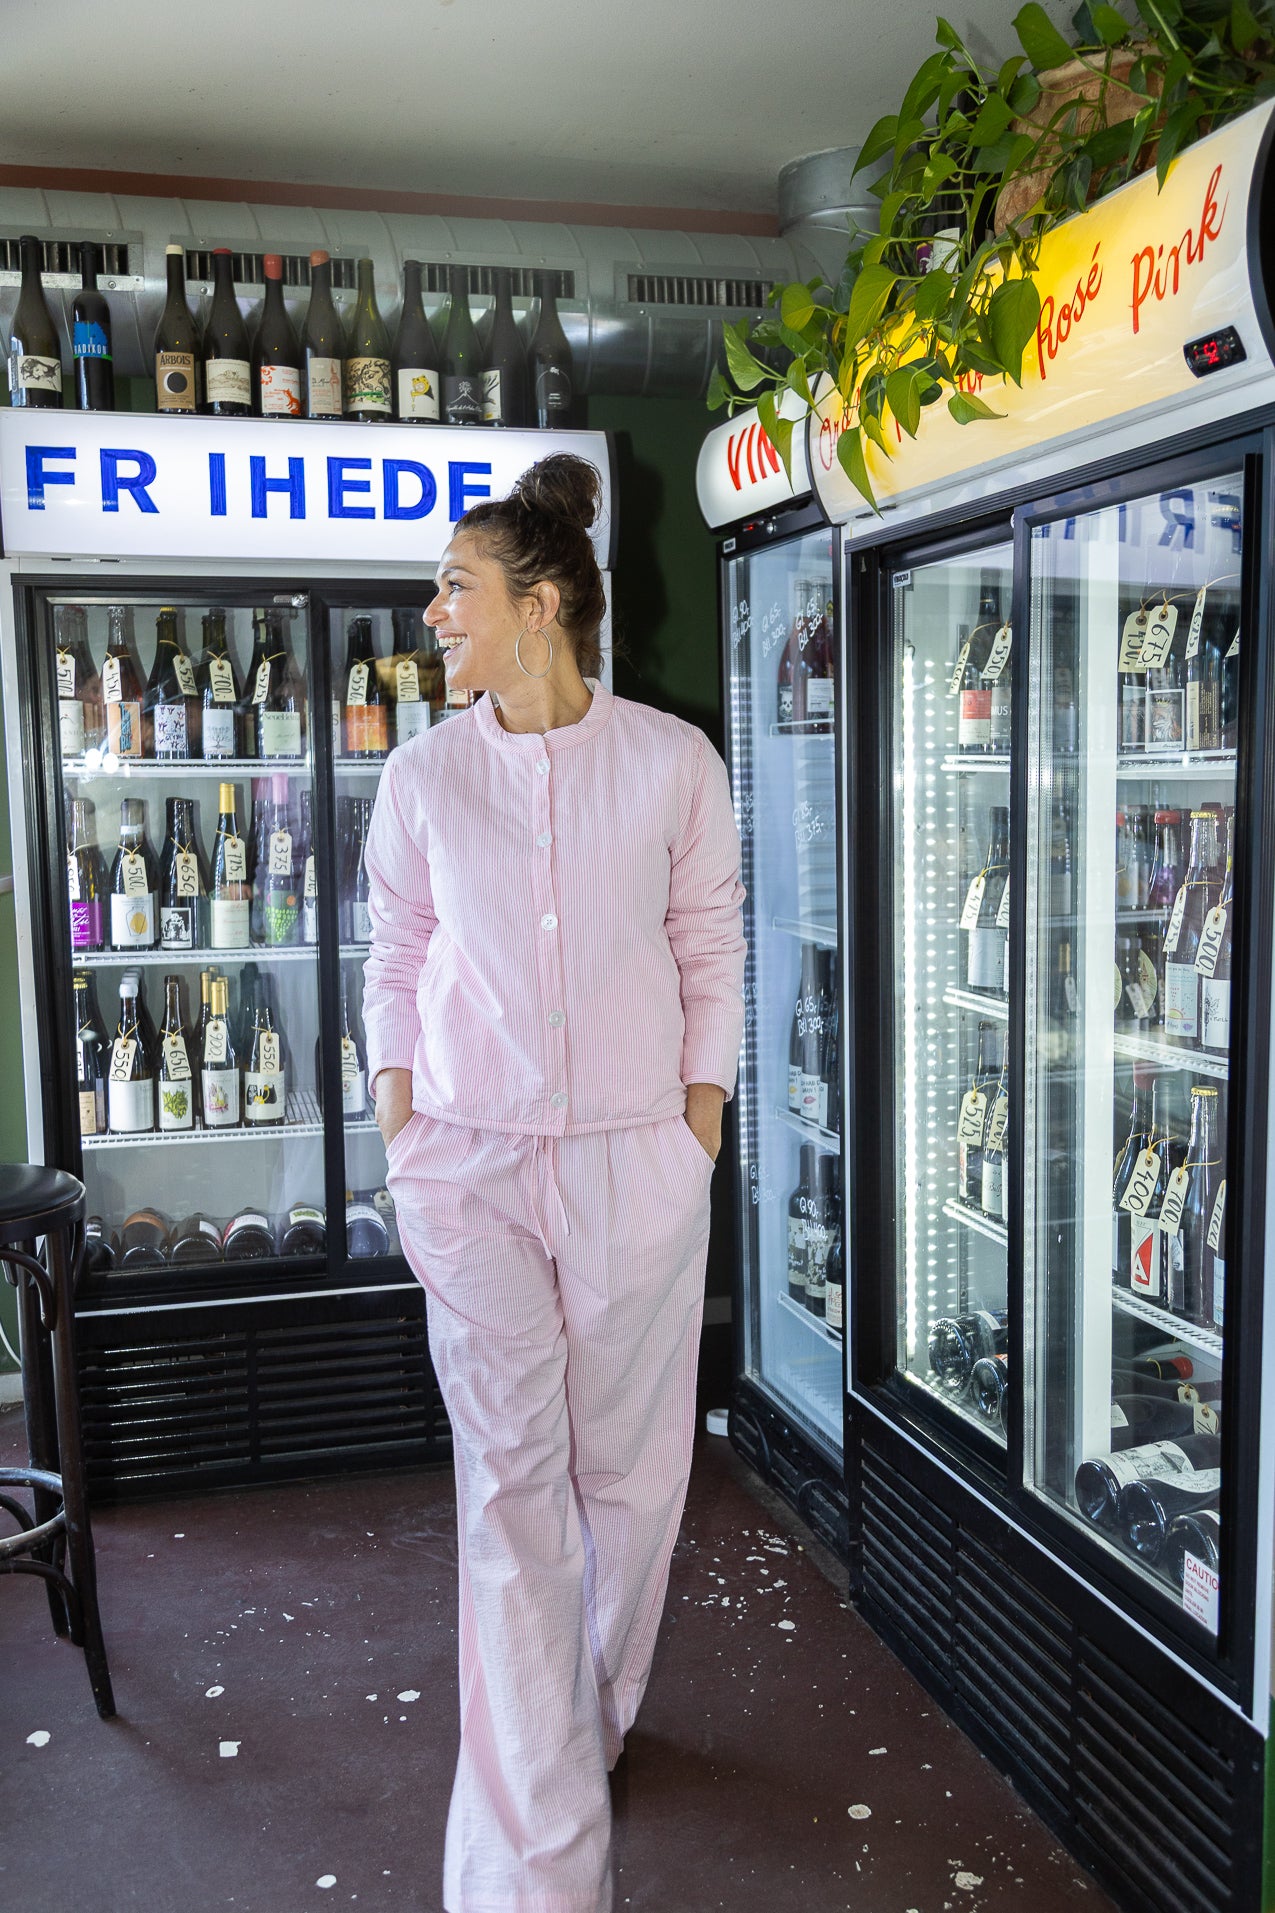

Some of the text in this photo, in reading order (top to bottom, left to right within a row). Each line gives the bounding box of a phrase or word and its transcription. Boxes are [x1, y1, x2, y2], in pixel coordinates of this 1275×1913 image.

[1036, 241, 1103, 380] Rosé
[1128, 164, 1230, 335] Pink
[160, 354, 191, 365] ARBOIS
